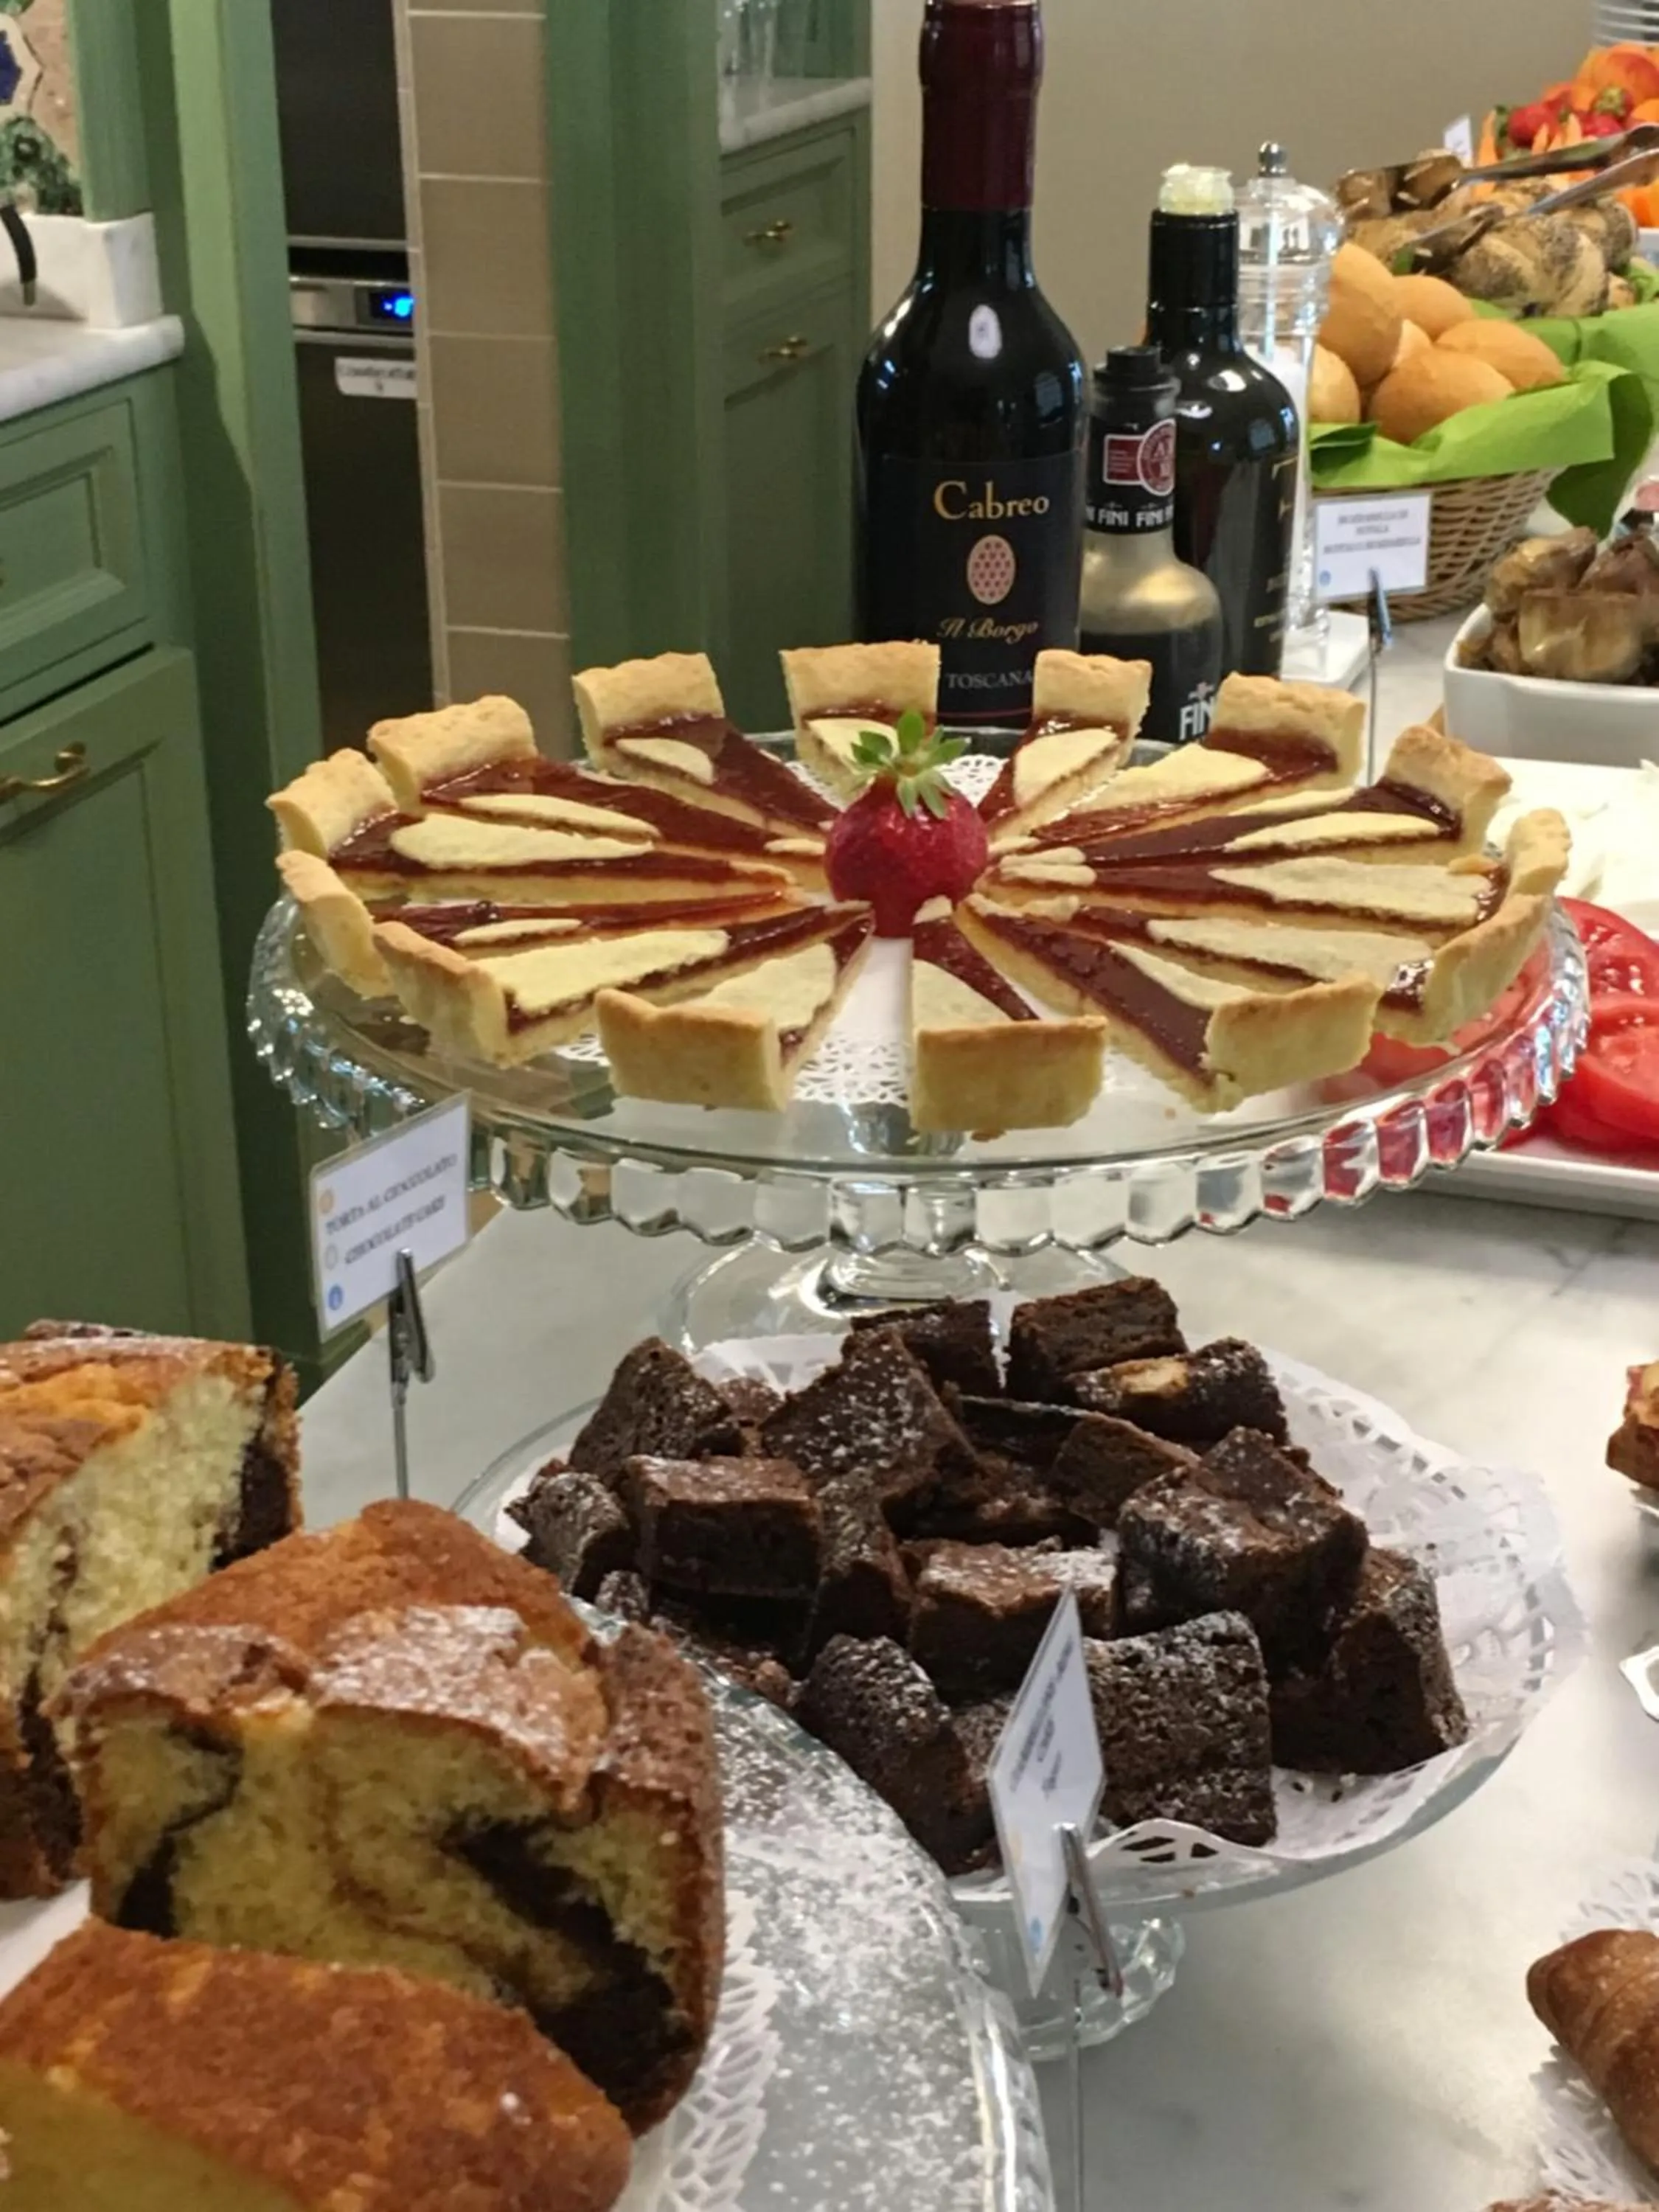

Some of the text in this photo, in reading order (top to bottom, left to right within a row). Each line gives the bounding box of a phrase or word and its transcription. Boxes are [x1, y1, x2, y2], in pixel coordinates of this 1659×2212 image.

[933, 480, 1050, 520] Cabreo
[967, 617, 1039, 644] Borgo
[945, 669, 1033, 689] TOSCANA
[1180, 696, 1215, 740] FIN
